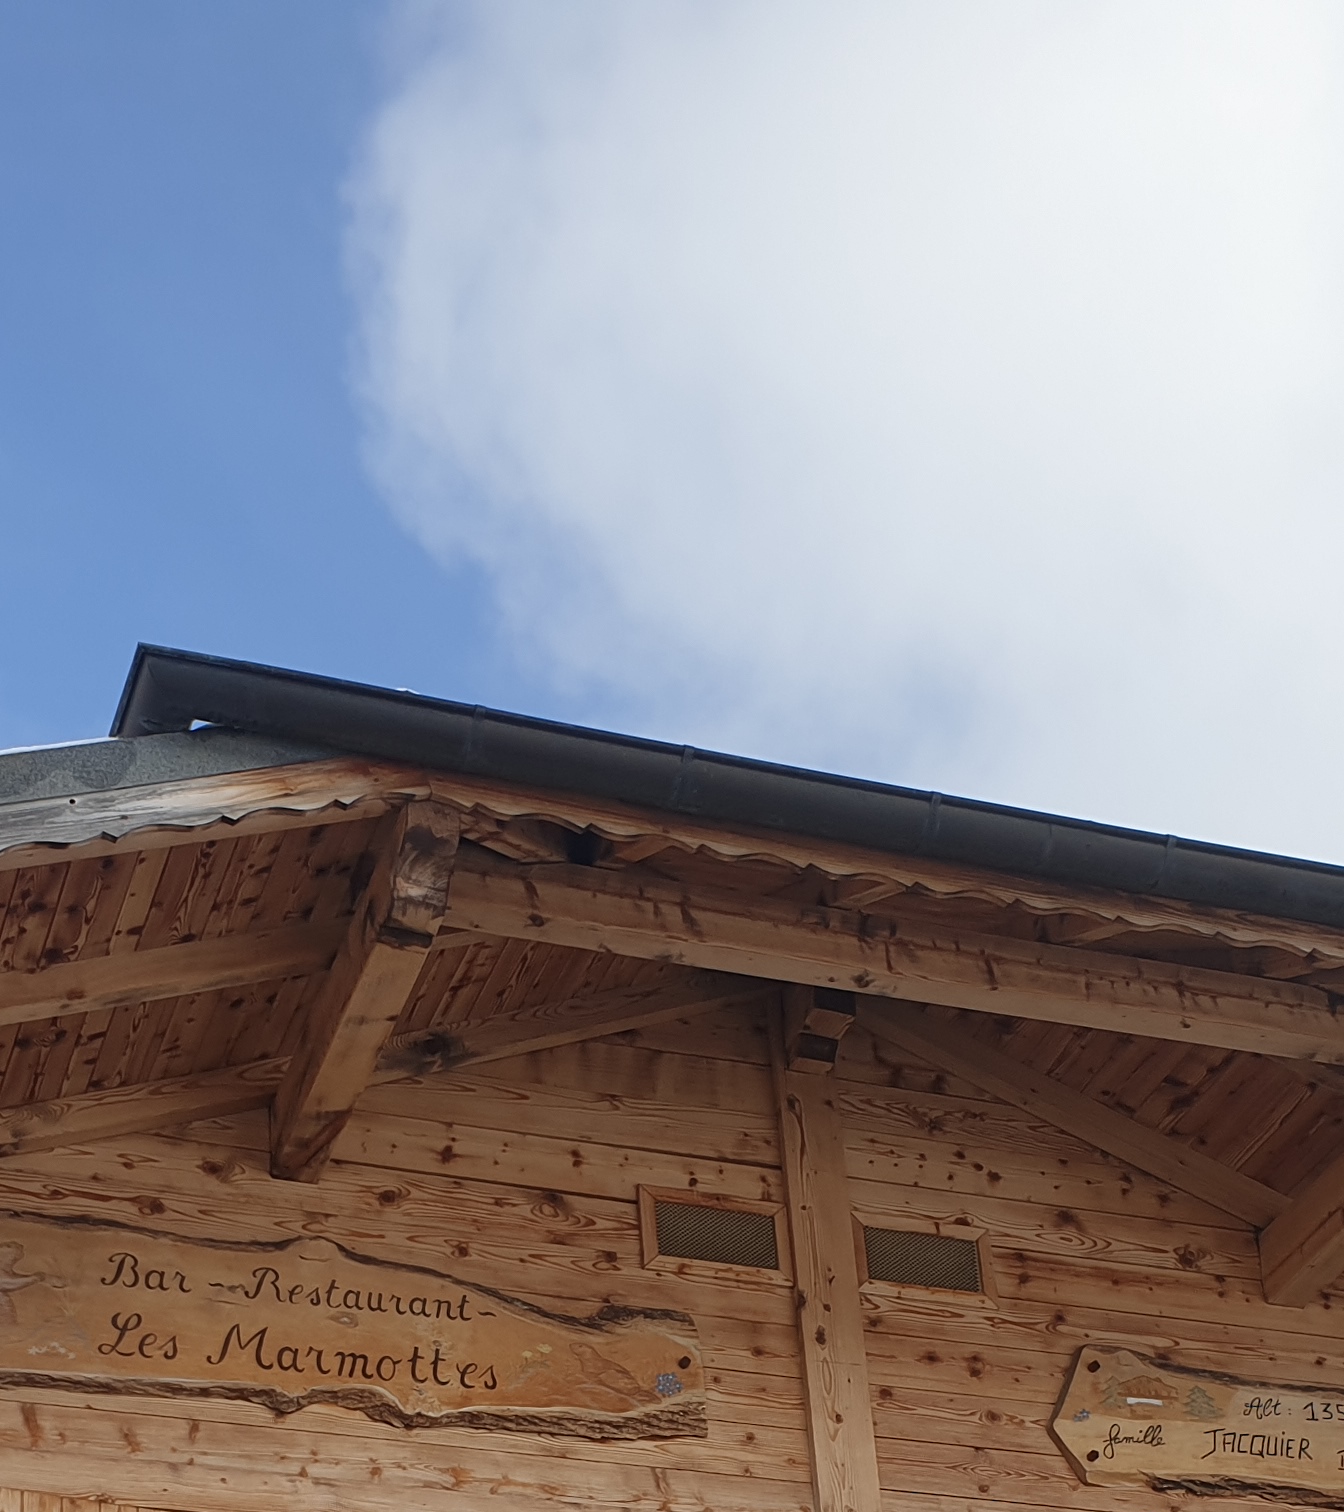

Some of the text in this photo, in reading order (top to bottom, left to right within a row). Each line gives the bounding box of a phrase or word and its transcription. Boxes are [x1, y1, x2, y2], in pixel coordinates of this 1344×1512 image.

[101, 1252, 192, 1293] Bar
[98, 1311, 499, 1390] Les Marmottes
